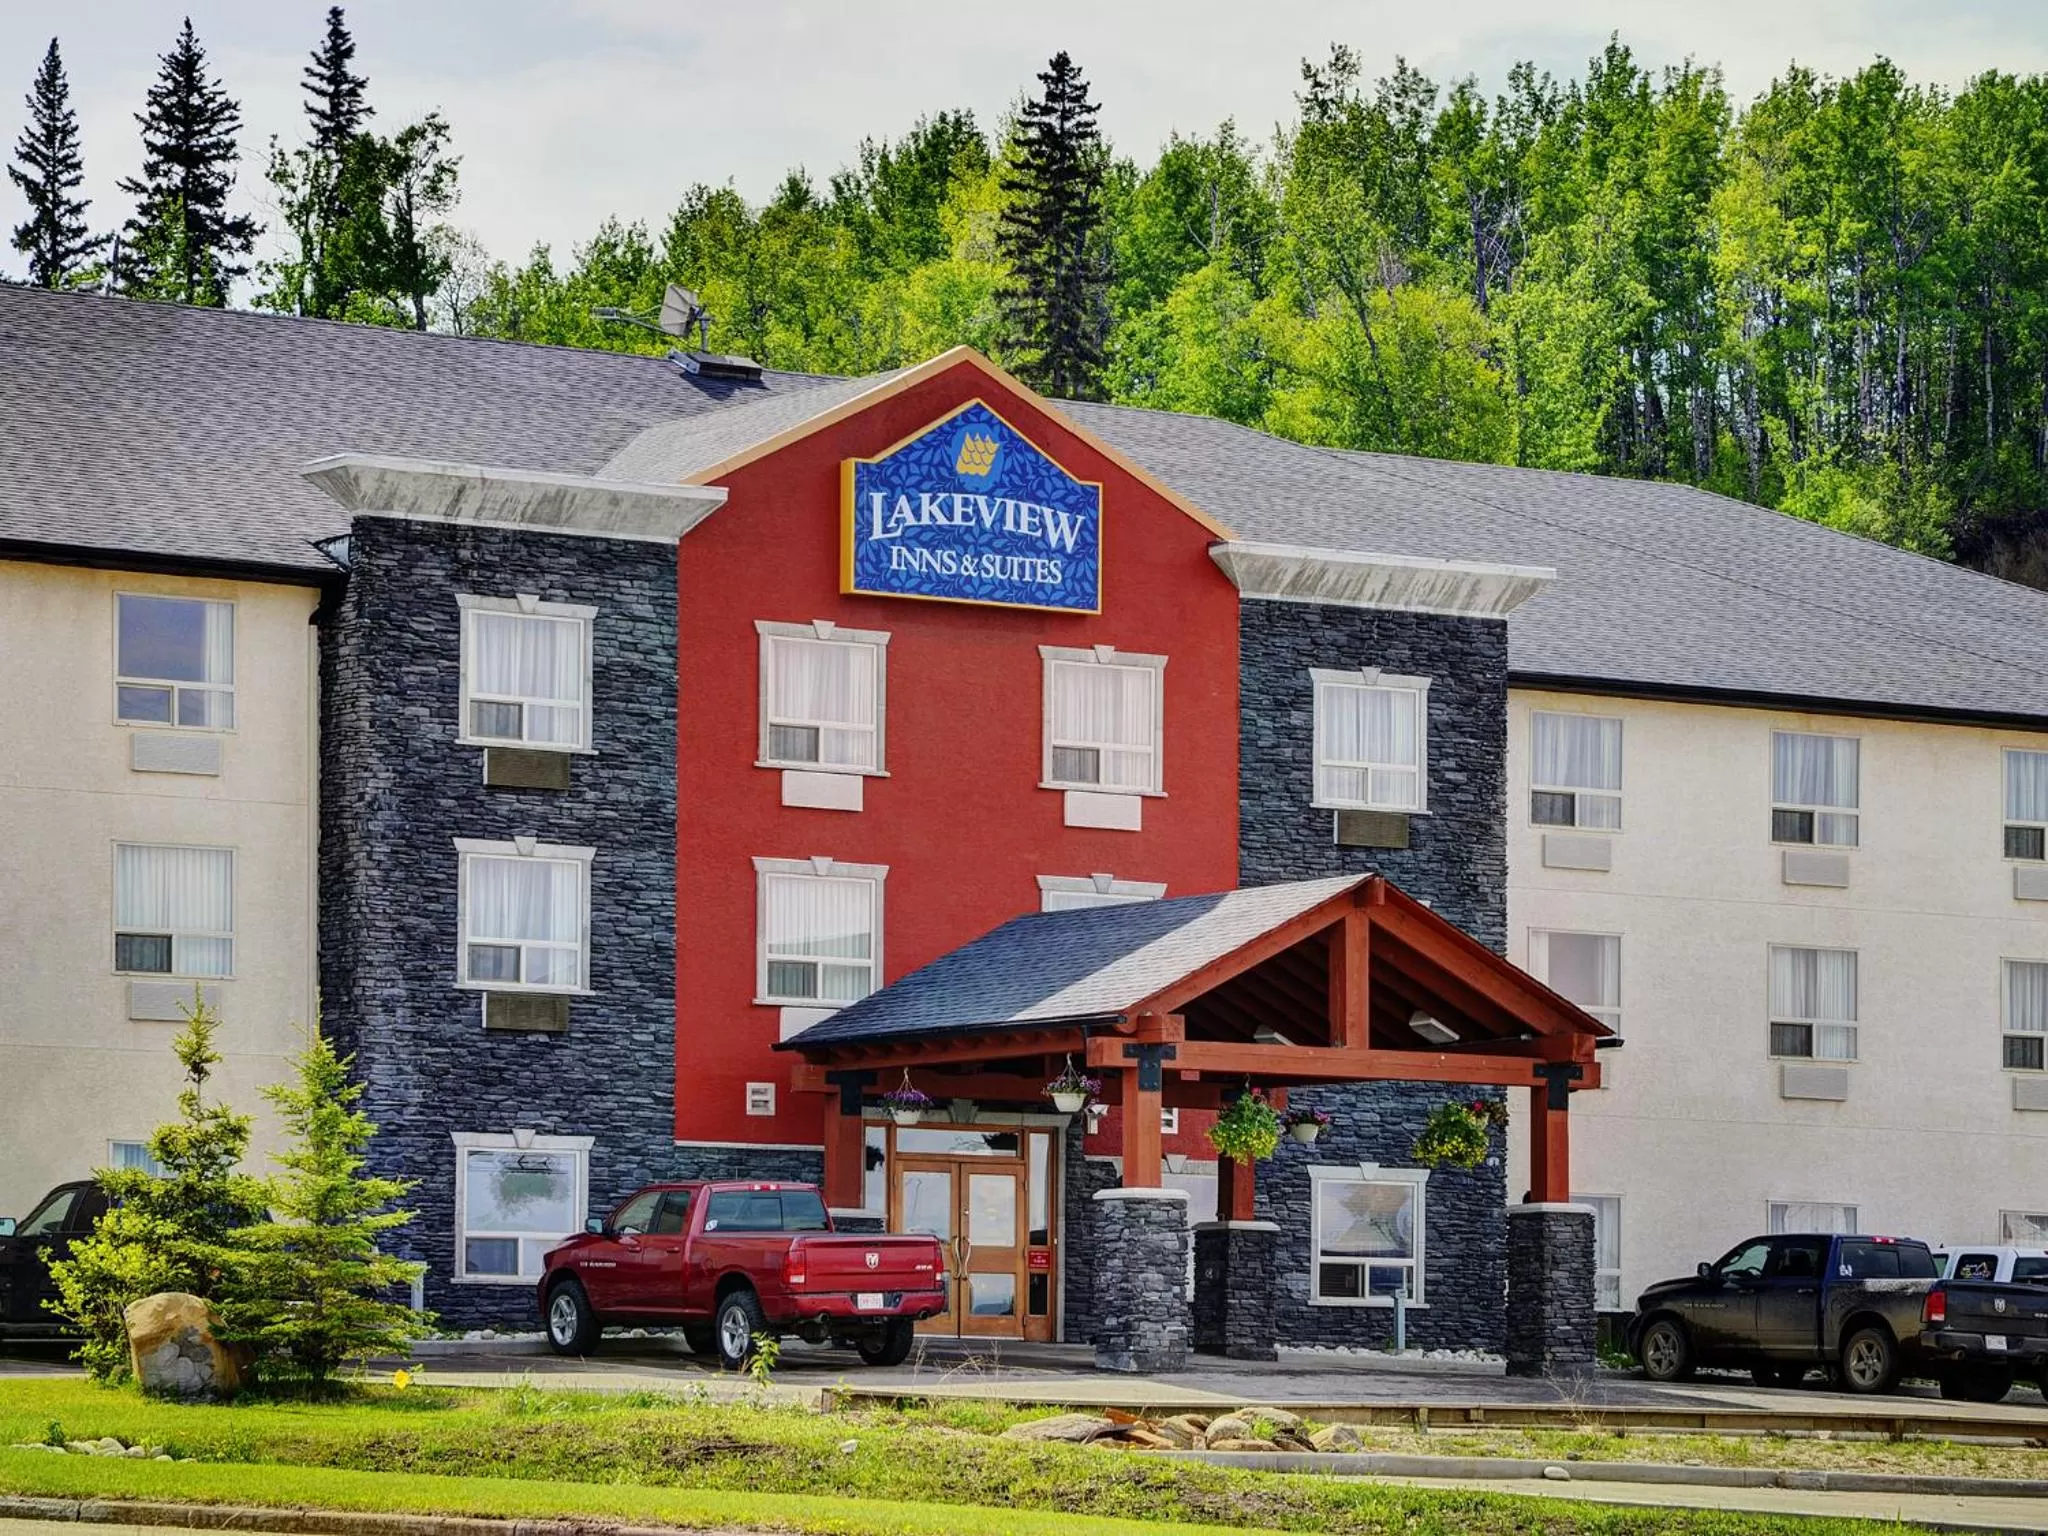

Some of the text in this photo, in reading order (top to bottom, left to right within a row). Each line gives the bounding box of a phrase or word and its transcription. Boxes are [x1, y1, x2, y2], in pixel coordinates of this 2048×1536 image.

[868, 492, 1086, 554] LAKEVIEW
[890, 545, 957, 575] INNS
[980, 554, 1062, 584] SUITES
